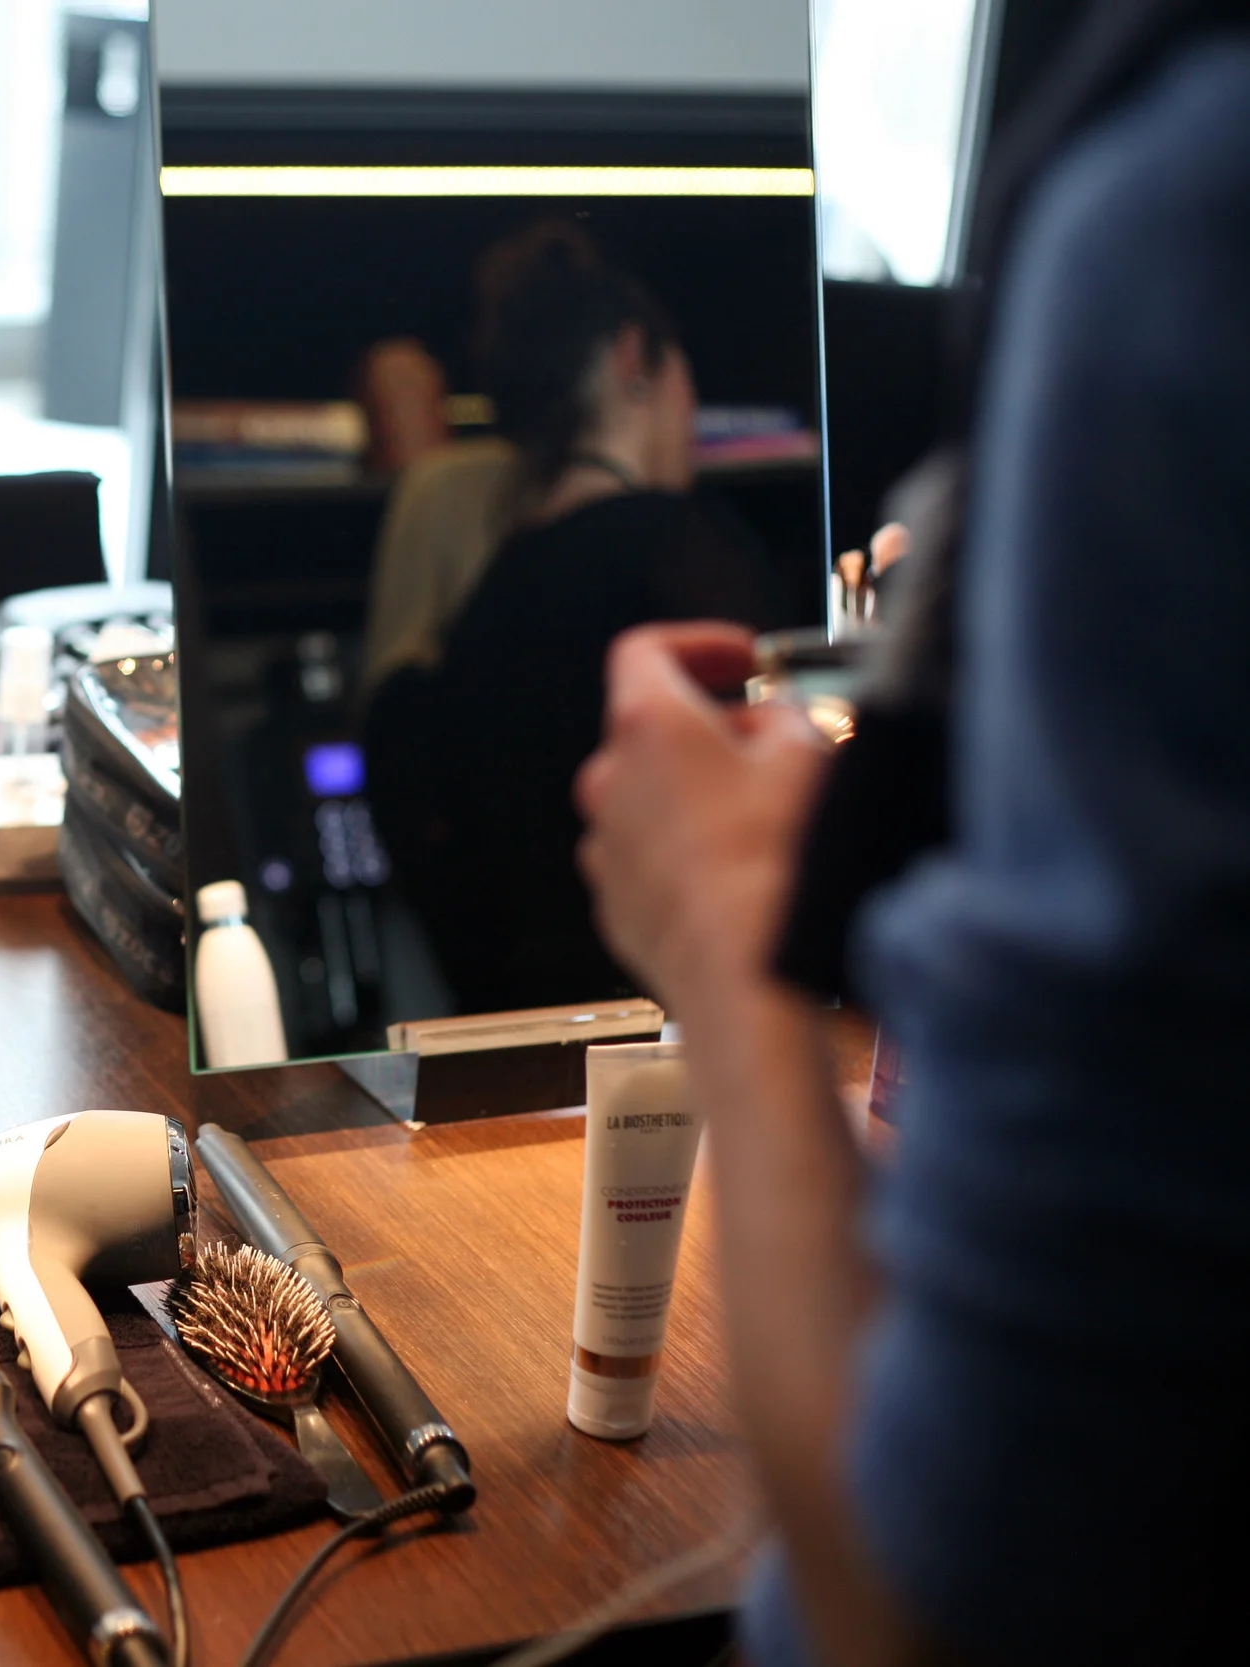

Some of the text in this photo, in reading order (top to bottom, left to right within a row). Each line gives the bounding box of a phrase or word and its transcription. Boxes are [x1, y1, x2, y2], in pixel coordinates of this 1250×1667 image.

[607, 1117, 620, 1130] LA
[607, 1197, 682, 1210] PROTECTION
[616, 1210, 672, 1223] COULEUR
